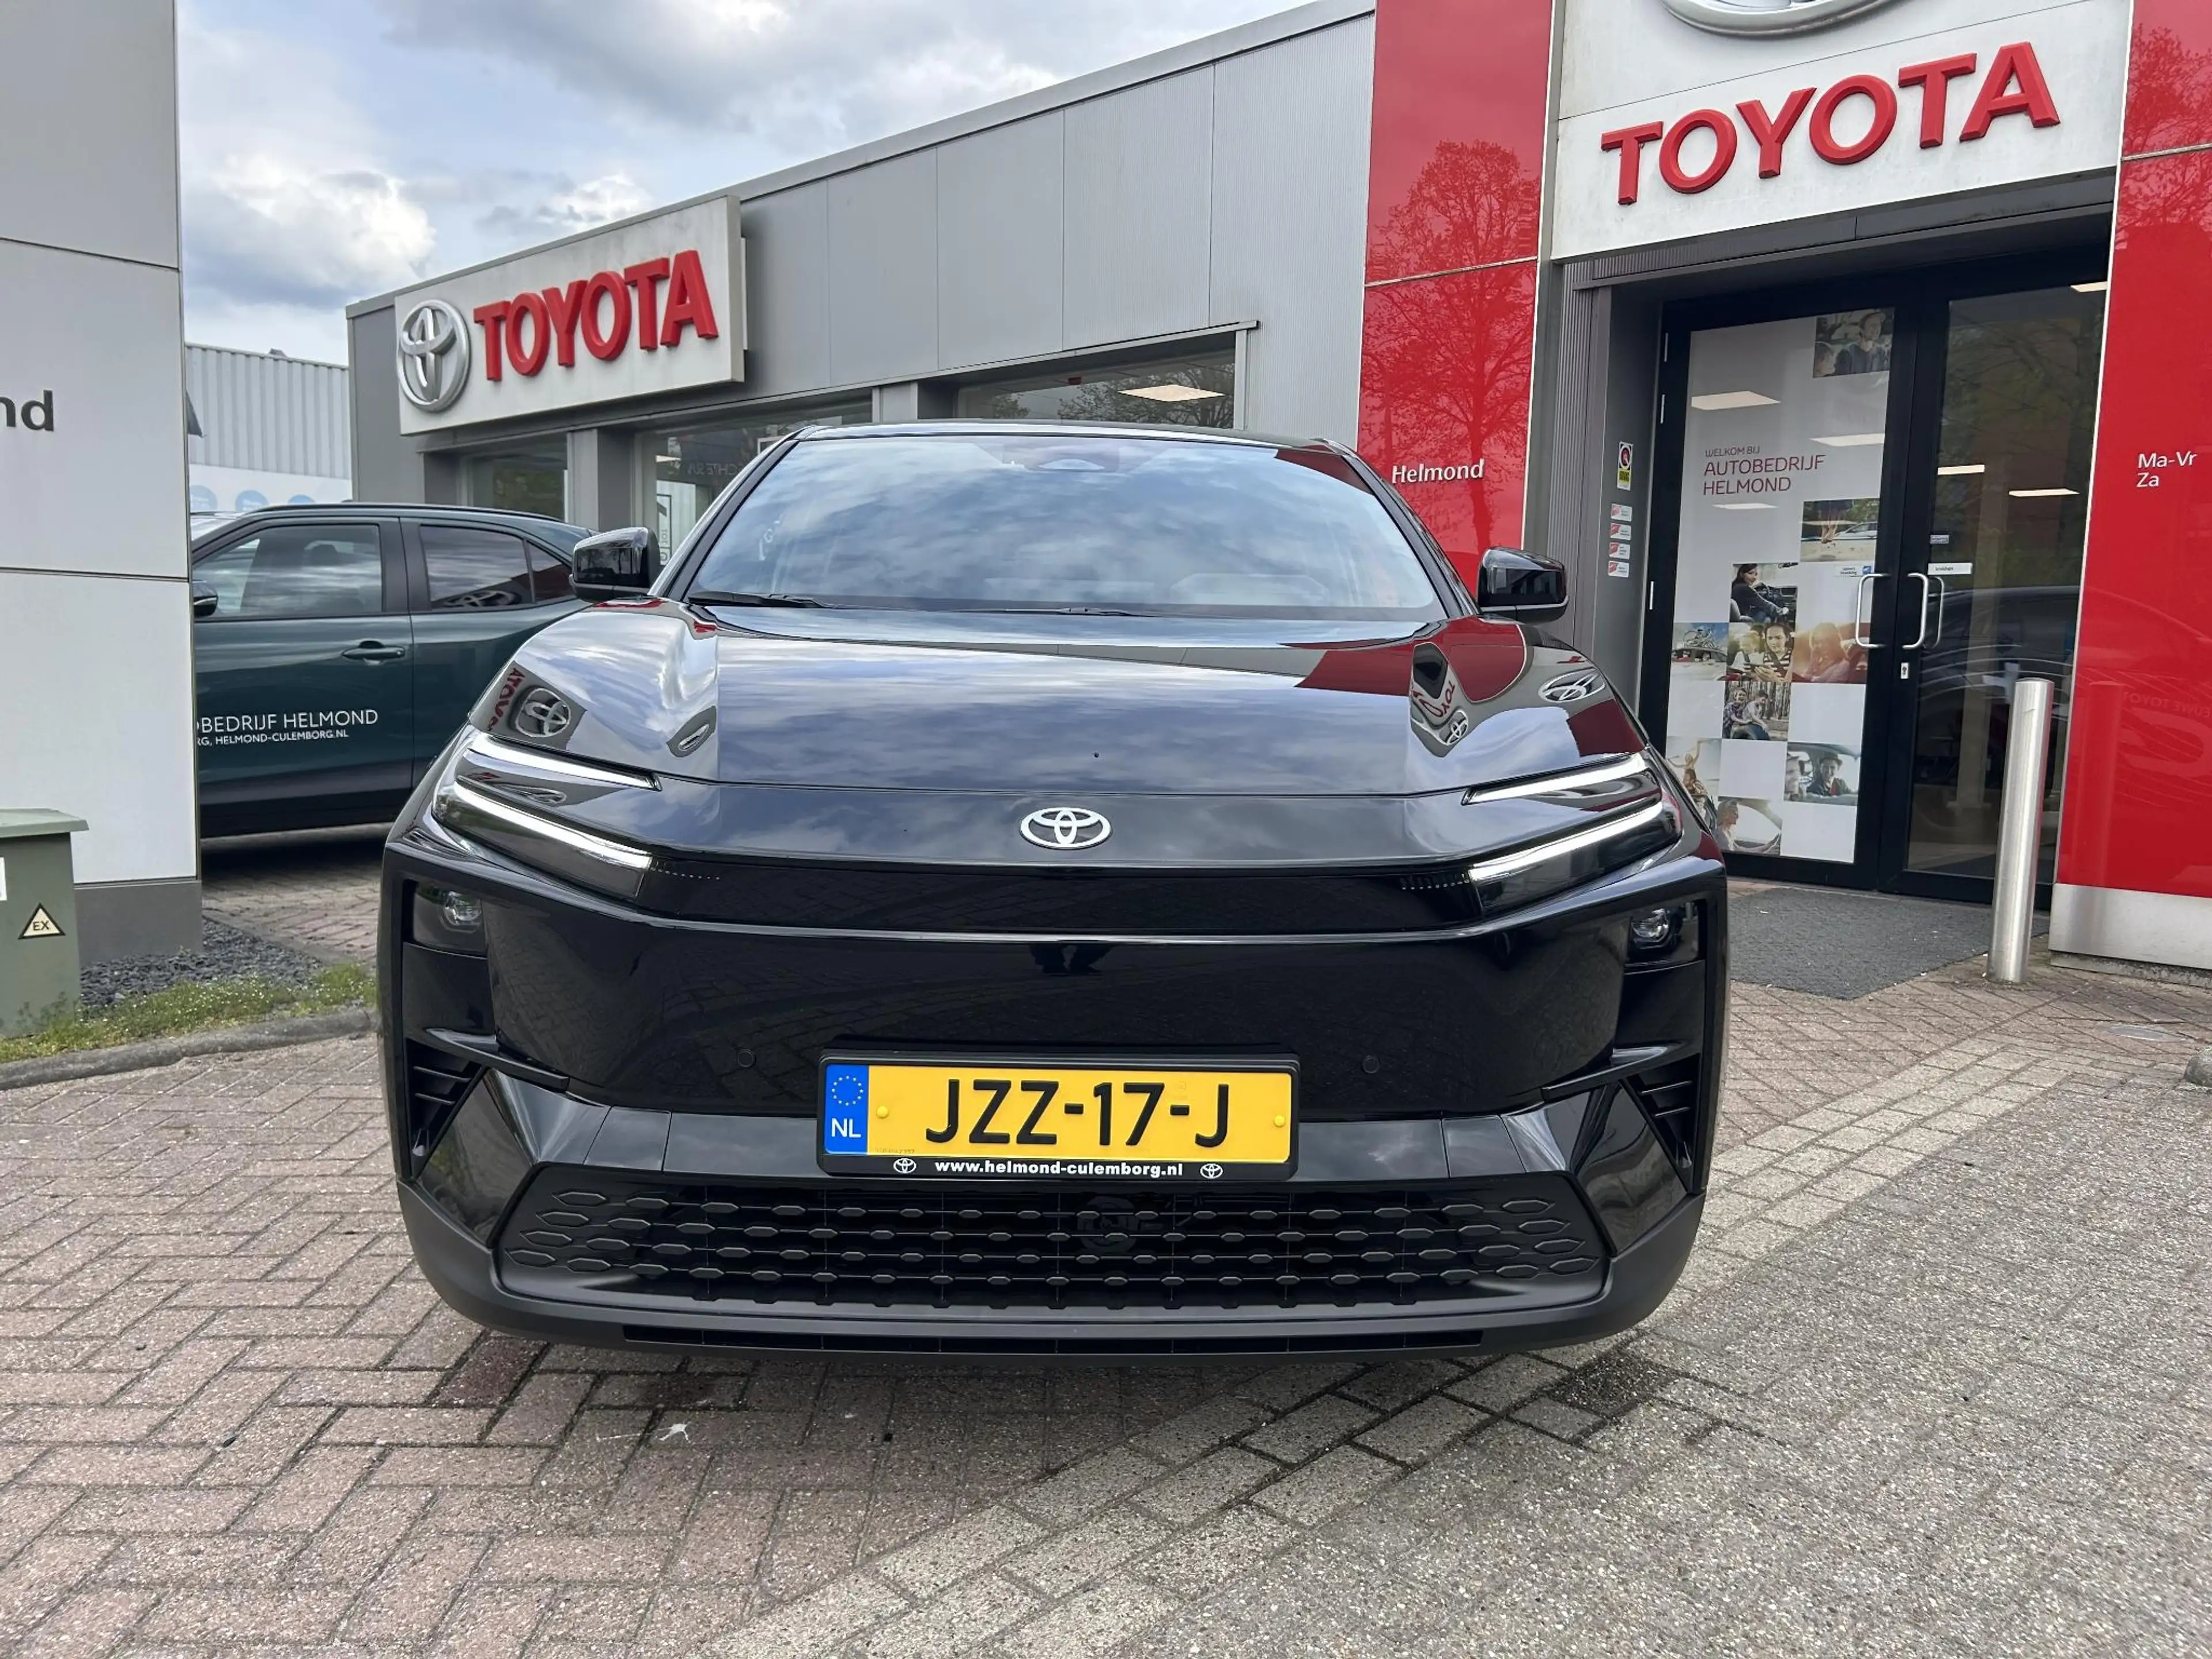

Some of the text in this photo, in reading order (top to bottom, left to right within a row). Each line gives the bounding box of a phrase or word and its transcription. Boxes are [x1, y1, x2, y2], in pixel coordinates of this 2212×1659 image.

[1601, 41, 2060, 206] TOYOTA
[474, 250, 718, 382] TOYOTA
[1705, 446, 1760, 457] WELKOM BIJ
[2138, 451, 2197, 469] Ma-Vr
[1392, 459, 1484, 484] Helmond
[1703, 454, 1827, 476] AUTOBEDRIJF
[1703, 476, 1791, 495] HELMOND
[2137, 472, 2160, 488] Za
[196, 709, 378, 733] BEDRIJF HELMOND
[215, 729, 349, 745] HELMOND-CULEMBORG.NL
[33, 921, 50, 931] EX
[925, 1078, 1230, 1147] JZZ-17-J
[831, 1119, 861, 1138] NL
[935, 1160, 1183, 1179] www.helmond-culemborg.nl
